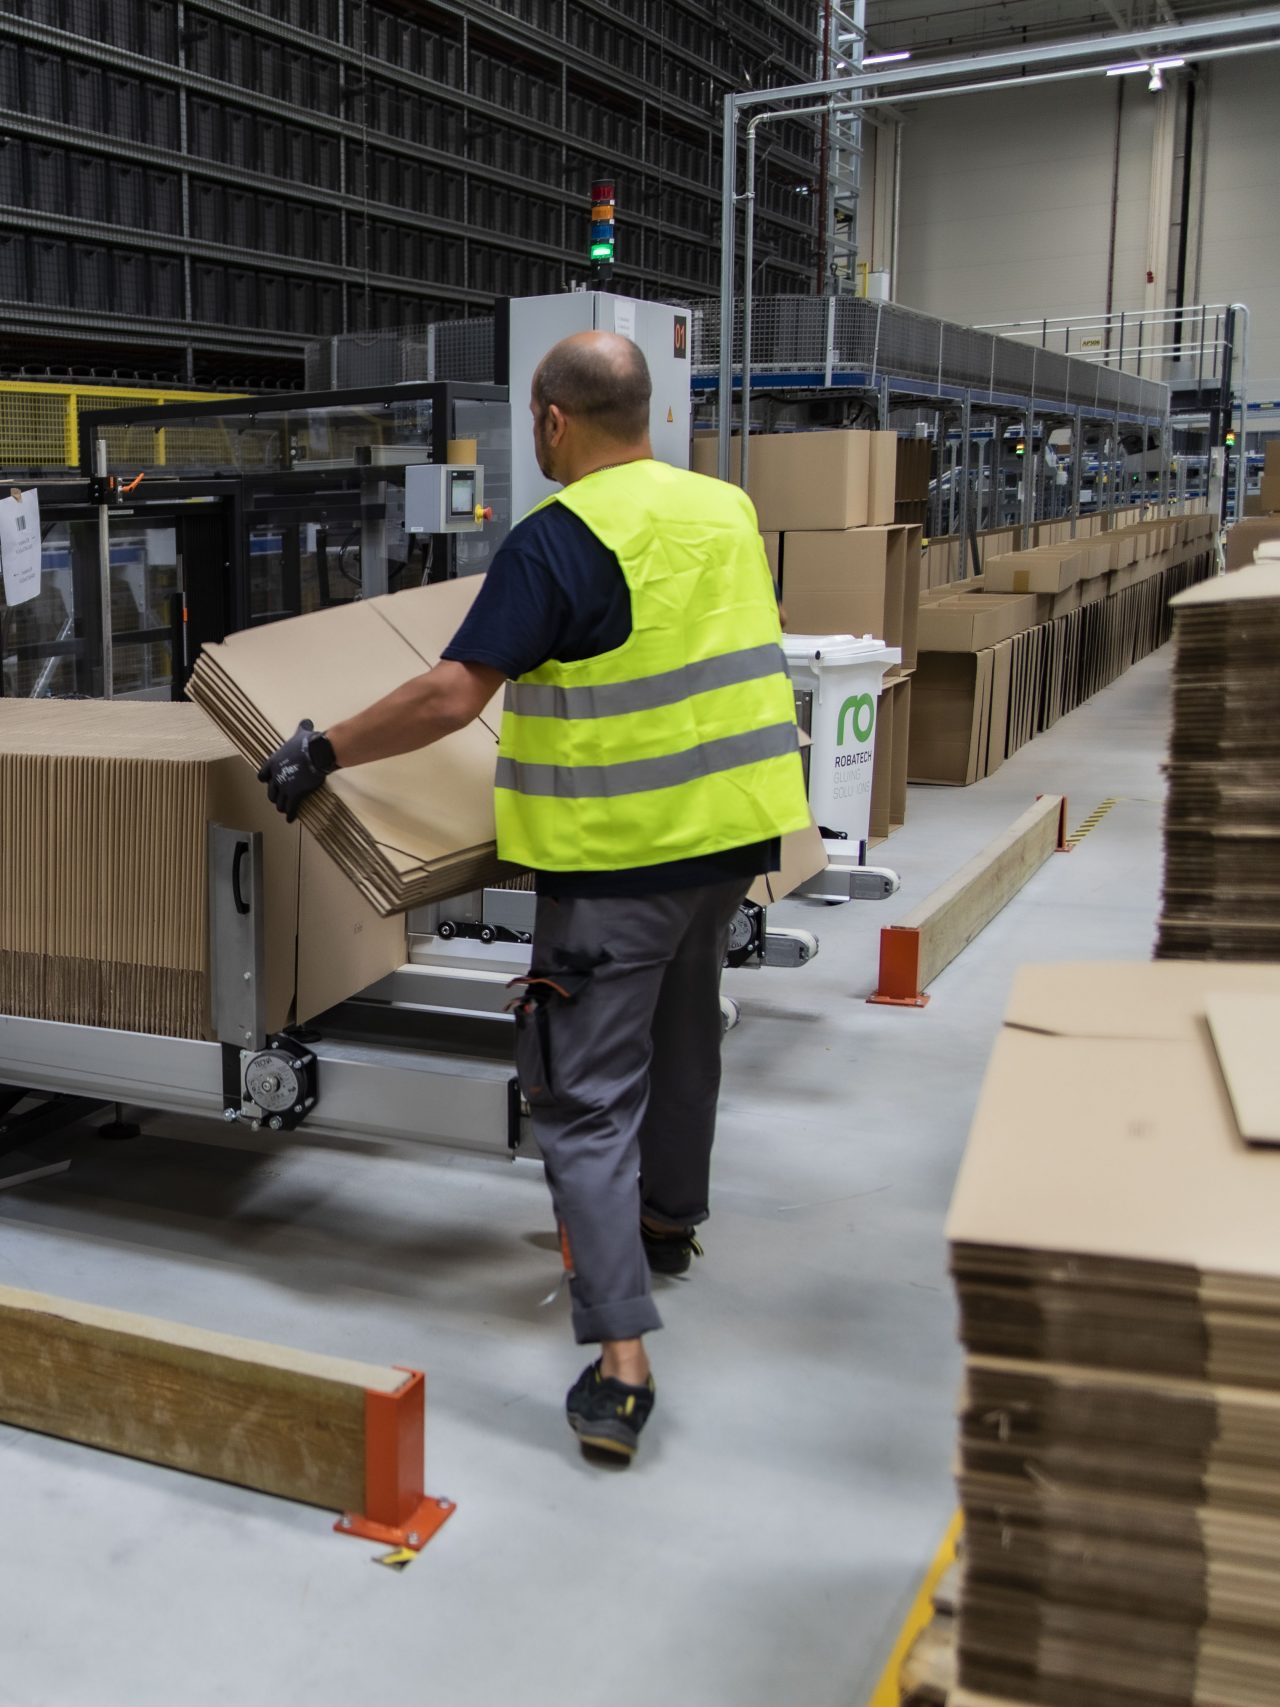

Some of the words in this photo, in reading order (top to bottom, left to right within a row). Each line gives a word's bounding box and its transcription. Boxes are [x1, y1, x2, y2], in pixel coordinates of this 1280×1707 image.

[675, 324, 685, 350] 01
[834, 750, 872, 768] ROBATECH
[833, 768, 861, 784] GLUING
[833, 780, 871, 800] SOLUIONS
